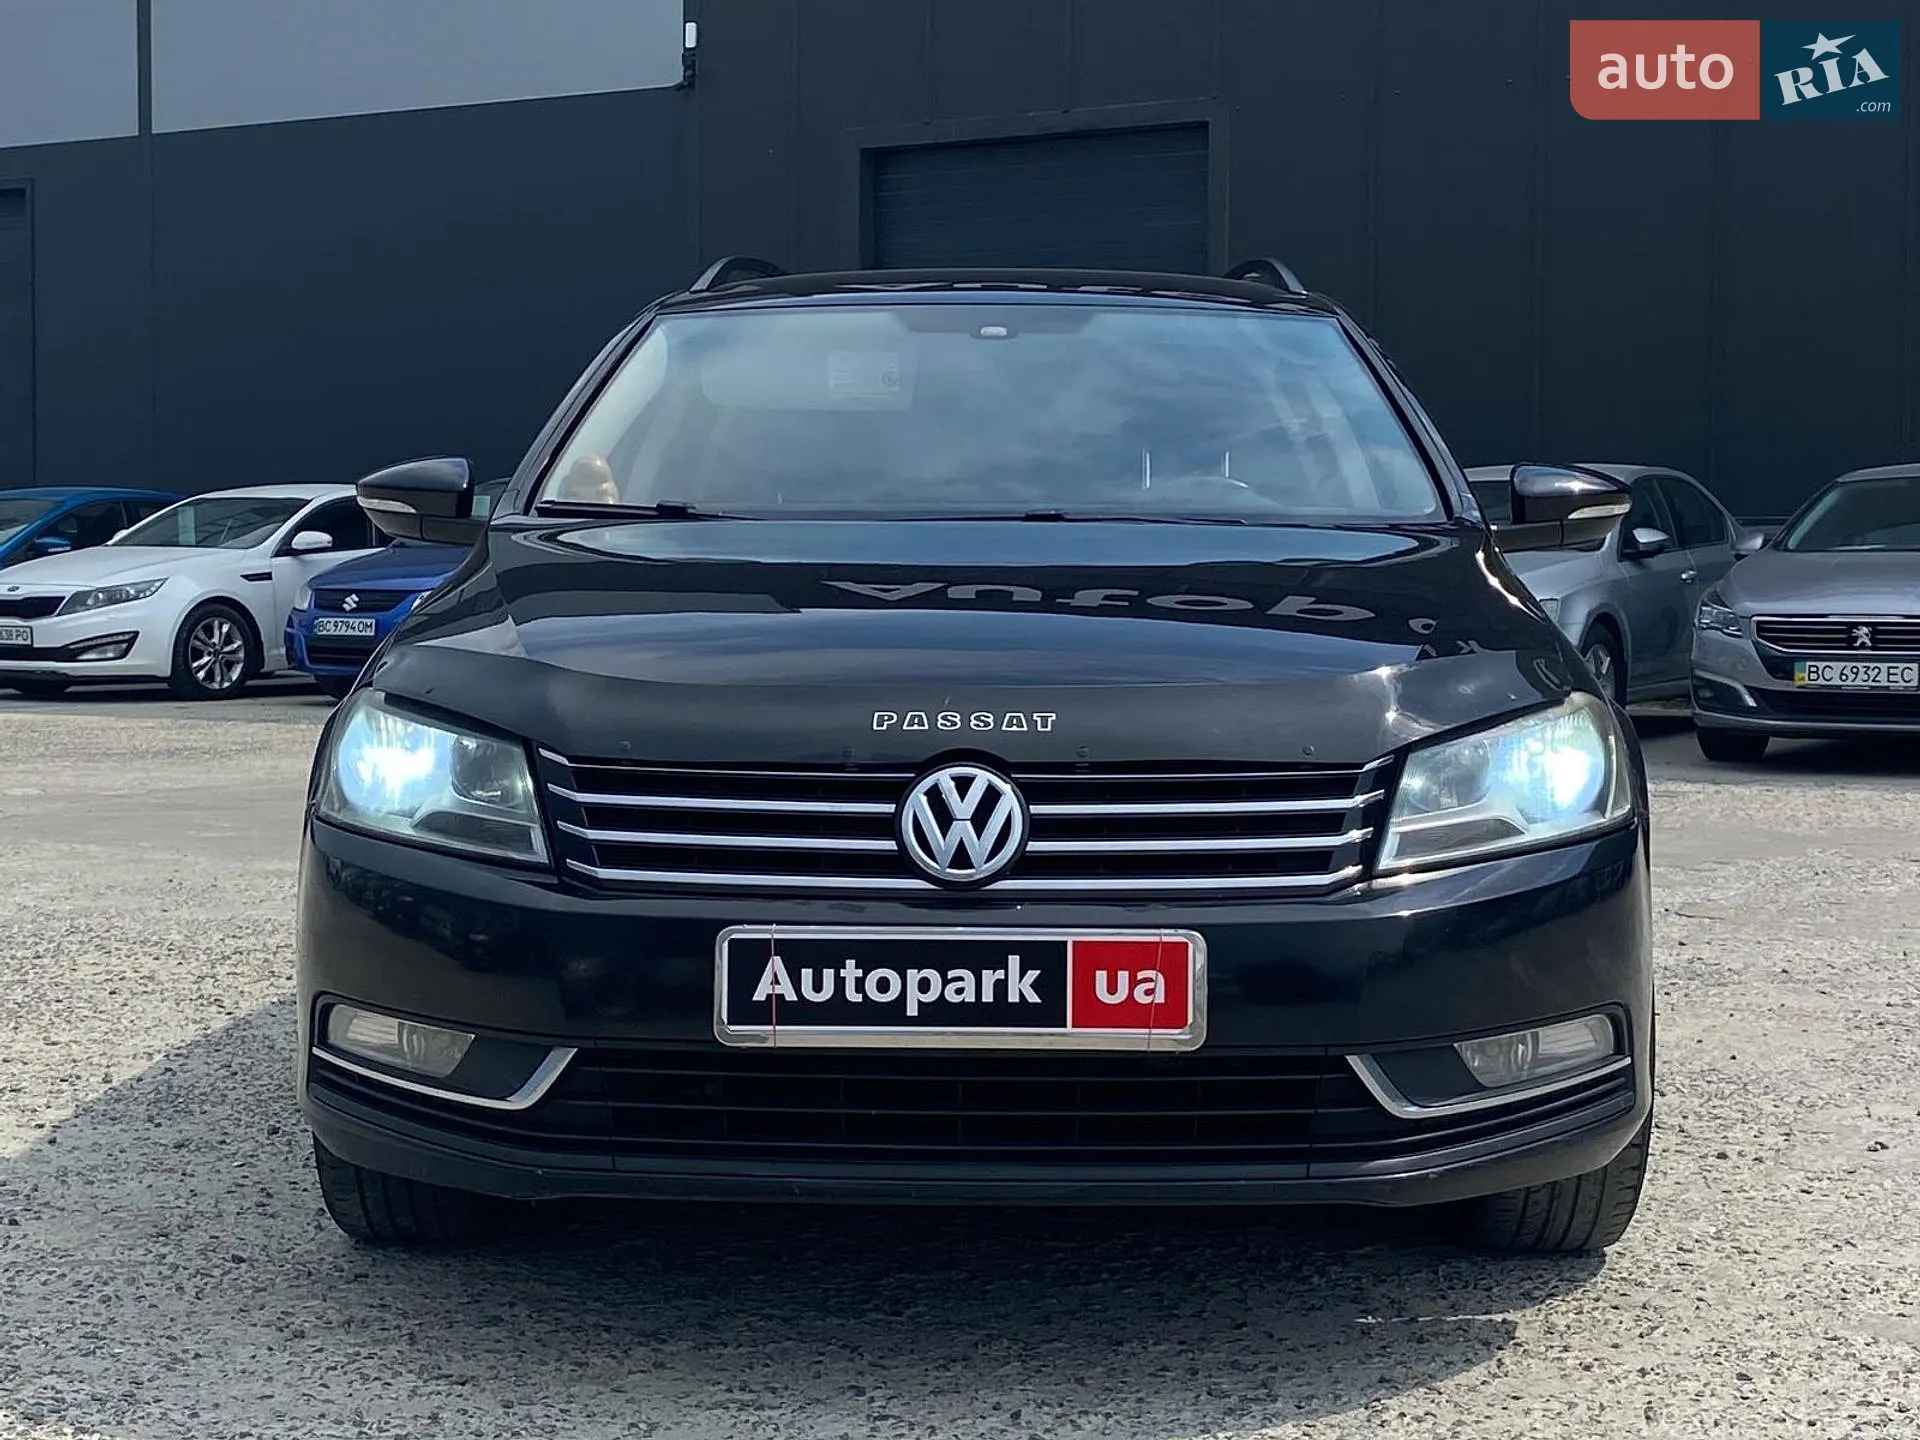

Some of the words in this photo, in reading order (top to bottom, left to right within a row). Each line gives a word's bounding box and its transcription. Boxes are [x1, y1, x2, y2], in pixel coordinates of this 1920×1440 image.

[1807, 664, 1834, 682] BC
[1839, 665, 1882, 683] 6932
[1887, 666, 1914, 684] EC
[872, 711, 1057, 732] PASSAT
[752, 955, 1042, 1017] Autopark
[1094, 968, 1166, 1005] ua
